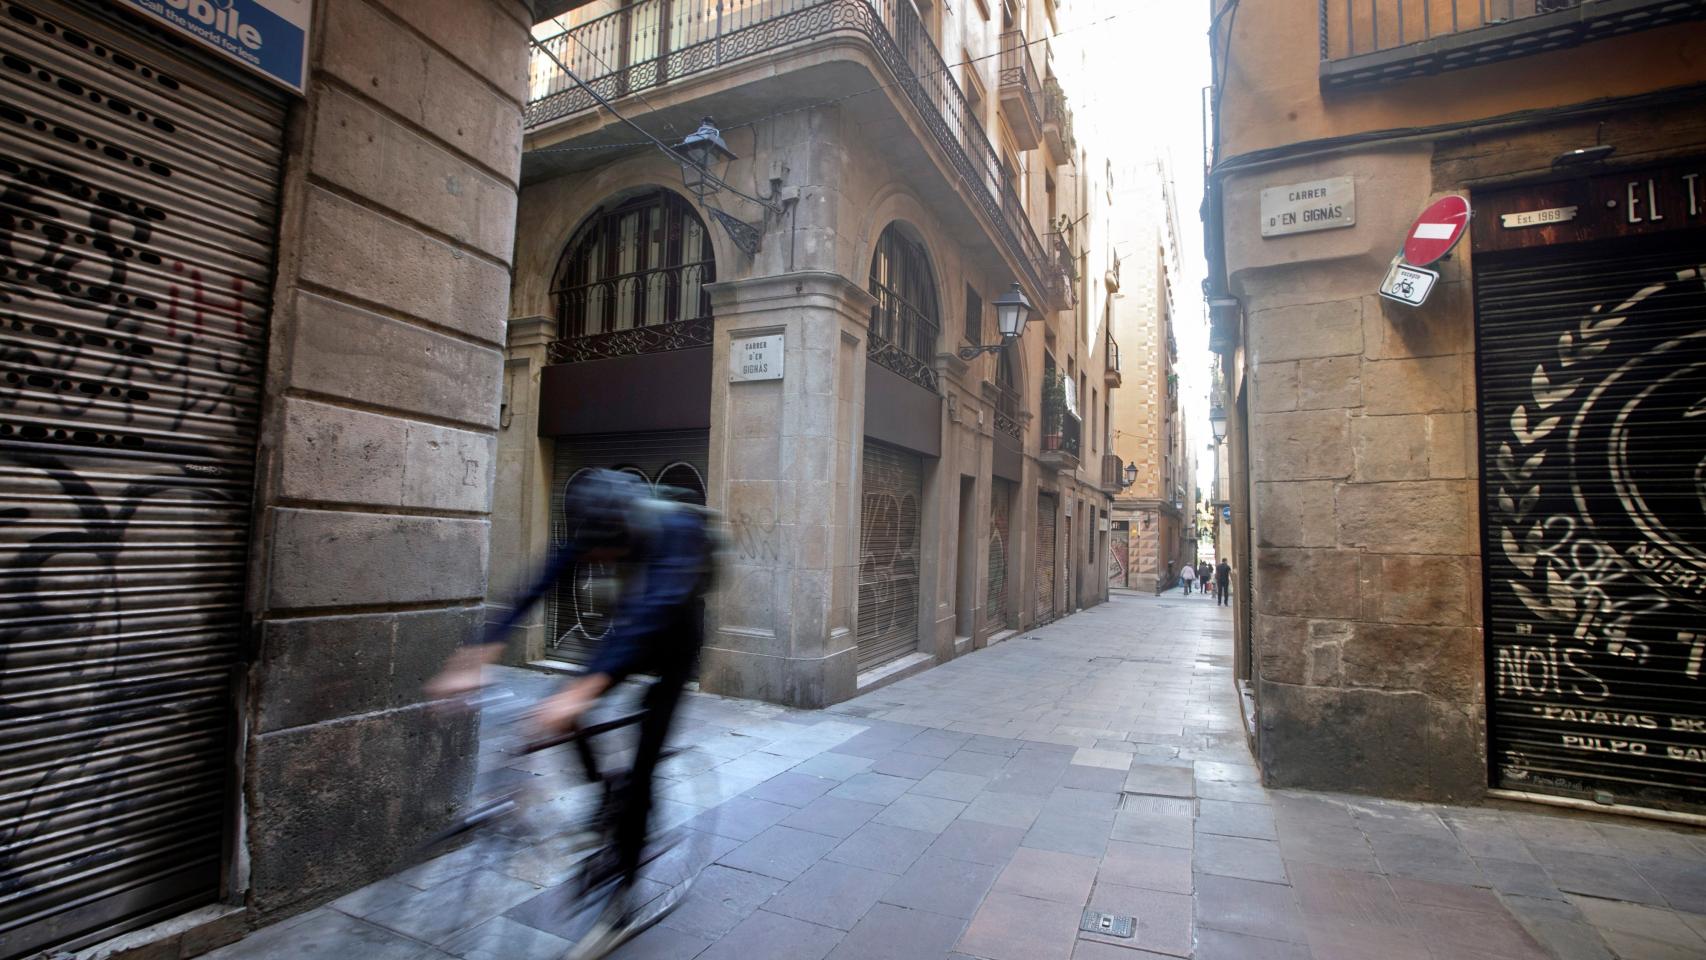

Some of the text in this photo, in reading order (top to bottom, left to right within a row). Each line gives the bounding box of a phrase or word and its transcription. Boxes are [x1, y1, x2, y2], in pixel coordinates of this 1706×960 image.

[165, 9, 188, 26] the
[187, 20, 220, 43] world
[222, 38, 236, 52] for
[237, 47, 262, 65] less
[1288, 187, 1327, 202] CARRER
[1628, 179, 1664, 223] EL
[1517, 210, 1561, 225] Est. 1969
[745, 341, 767, 350] CARRER
[1562, 734, 1648, 756] PULPO
